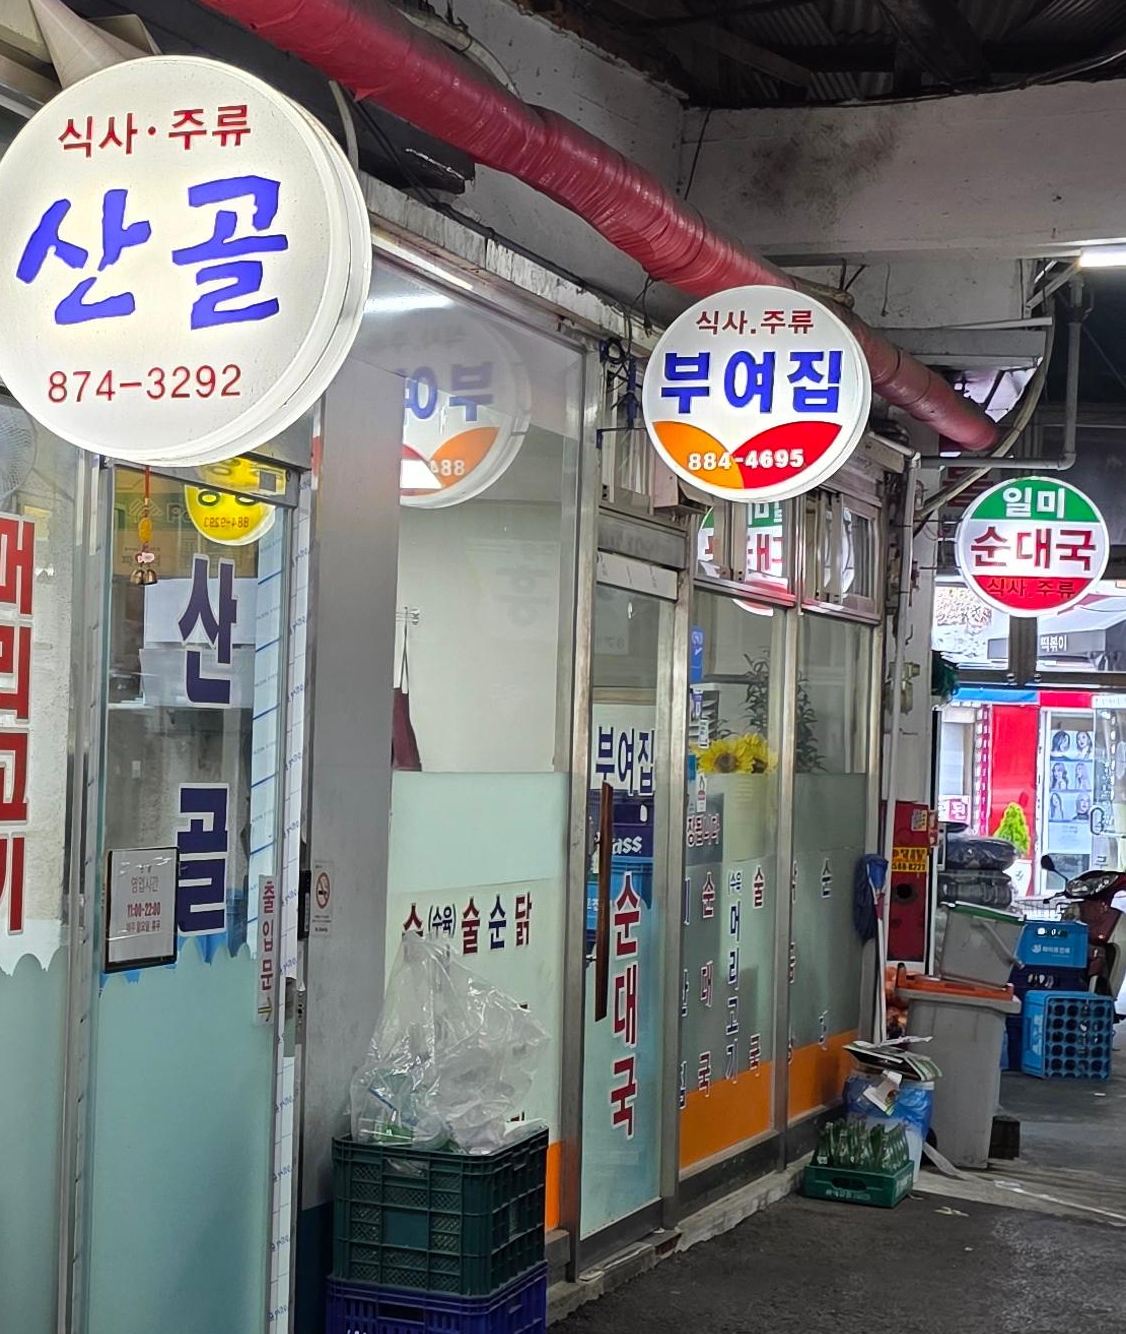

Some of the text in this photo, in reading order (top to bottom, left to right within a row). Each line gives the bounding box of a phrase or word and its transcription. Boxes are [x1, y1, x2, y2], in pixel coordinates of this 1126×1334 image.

[16, 175, 288, 330] 산골
[48, 364, 241, 403] 874-3292
[661, 350, 843, 413] 부여집
[688, 449, 804, 471] 884-4695
[1003, 487, 1065, 518] 일미
[971, 526, 1096, 571] 순대국
[177, 556, 238, 935] 산골
[596, 726, 655, 795] 부여집
[611, 835, 642, 855] ass
[610, 872, 641, 1138] 순대국
